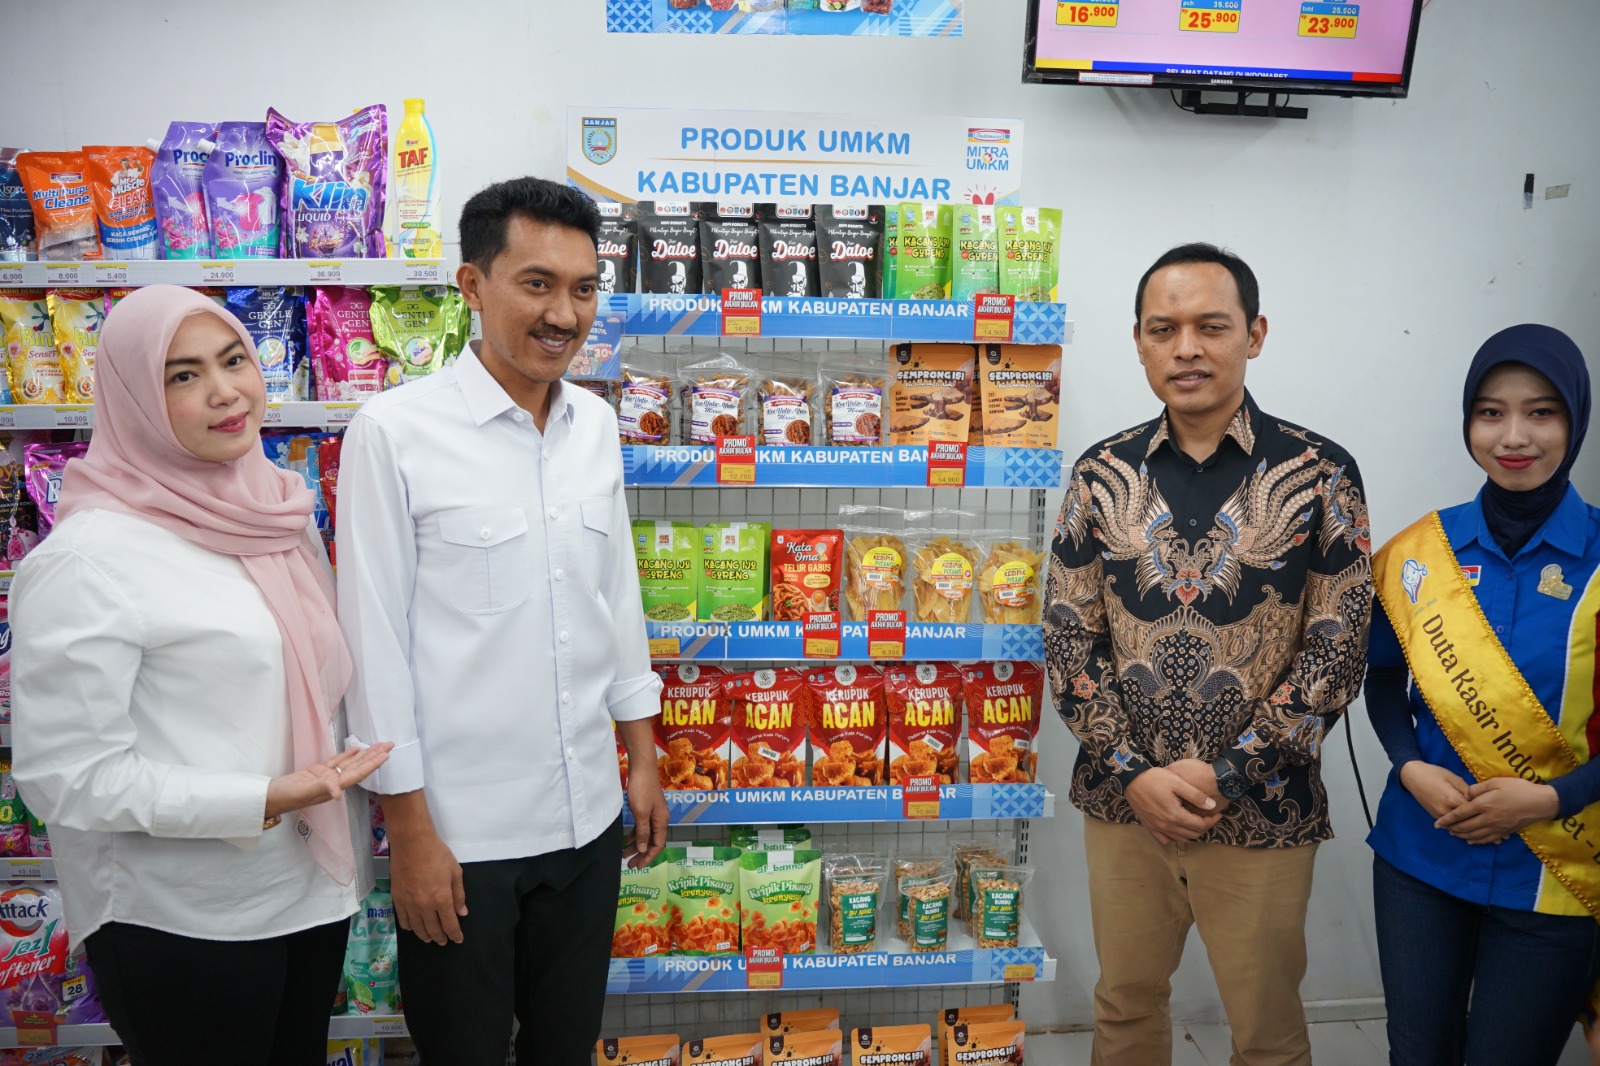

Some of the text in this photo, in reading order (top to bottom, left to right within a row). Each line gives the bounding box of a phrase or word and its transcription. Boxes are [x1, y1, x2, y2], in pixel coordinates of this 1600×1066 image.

[1070, 6, 1115, 22] 16.900
[1188, 12, 1237, 28] 25.900
[1308, 17, 1354, 34] 23.900
[682, 128, 910, 155] PRODUK UMKM
[398, 147, 428, 168] TAF
[966, 146, 1008, 158] MITRA
[225, 152, 277, 167] Proclin
[966, 159, 1008, 171] UMKM
[111, 178, 146, 195] Muscle
[638, 170, 950, 200] KABUPATEN BANJAR
[33, 186, 88, 200] Multi Purp
[109, 188, 148, 209] CLEAR
[292, 178, 368, 212] Klin
[44, 194, 90, 210] Cleane
[298, 212, 332, 223] LIQUID
[597, 240, 628, 256] atoe
[904, 236, 938, 248] KACANG
[960, 240, 996, 250] KACANG
[1006, 240, 1041, 251] KACANG
[652, 239, 697, 258] Datoe
[713, 239, 758, 258] Datoe
[772, 240, 816, 260] Datoe
[830, 241, 874, 260] Datoe
[912, 249, 944, 258] GORENG
[968, 251, 998, 262] GOREN
[1014, 252, 1048, 263] GORENG
[729, 292, 753, 301] PROMO
[983, 297, 1006, 306] PROMO
[650, 298, 969, 317] PRODUK KABUPATEN BANJAR
[248, 310, 292, 320] GENTLE
[393, 310, 435, 319] GENTLE
[258, 319, 284, 328] GEN
[404, 319, 426, 328] GEN
[21, 326, 57, 347] Rin
[897, 371, 950, 381] SEMPRONG
[988, 371, 1042, 381] SEMPRONG
[723, 438, 746, 447] PROMO
[935, 444, 959, 453] PROMO
[655, 450, 892, 464] PRODU KABUPATEN
[787, 542, 812, 553] Kata
[638, 559, 673, 569] KACANG
[704, 560, 738, 570] KACANG
[784, 564, 831, 572] TELUR GABUS
[646, 570, 683, 580] GORENG
[711, 570, 749, 580] GORENG
[809, 615, 833, 623] PROMO
[875, 613, 898, 621] PROMO
[660, 625, 732, 637] PRODUK
[738, 625, 789, 638] UMKM
[1422, 614, 1458, 673] Duta
[1451, 668, 1499, 730] Kasir
[668, 687, 711, 698] KERUPUK
[745, 690, 788, 702] KERUPUK
[826, 688, 869, 701] KERUPUK
[908, 687, 950, 699] KERUPUK
[986, 684, 1025, 698] KERUPUK
[662, 700, 716, 726] ACAN
[822, 701, 875, 729] ACAN
[905, 701, 954, 727] ACAN
[983, 696, 1032, 724] ACAN
[746, 703, 793, 730] ACAN
[664, 788, 887, 804] PRODUK UMKM KABUPATEN
[667, 876, 734, 893] Kripik Pisang
[749, 881, 812, 898] Kripik Pisang
[626, 886, 660, 898] Pisang
[849, 896, 871, 904] KACANG
[367, 908, 394, 918] mam
[753, 950, 775, 958] PROMO
[665, 960, 732, 972] PRODUK
[793, 954, 888, 968] KABUPATEN
[893, 954, 956, 966] BANJAR
[67, 984, 83, 996] 28
[860, 1052, 911, 1064] SEMPRONG
[956, 1048, 1004, 1061] SEMPRONG
